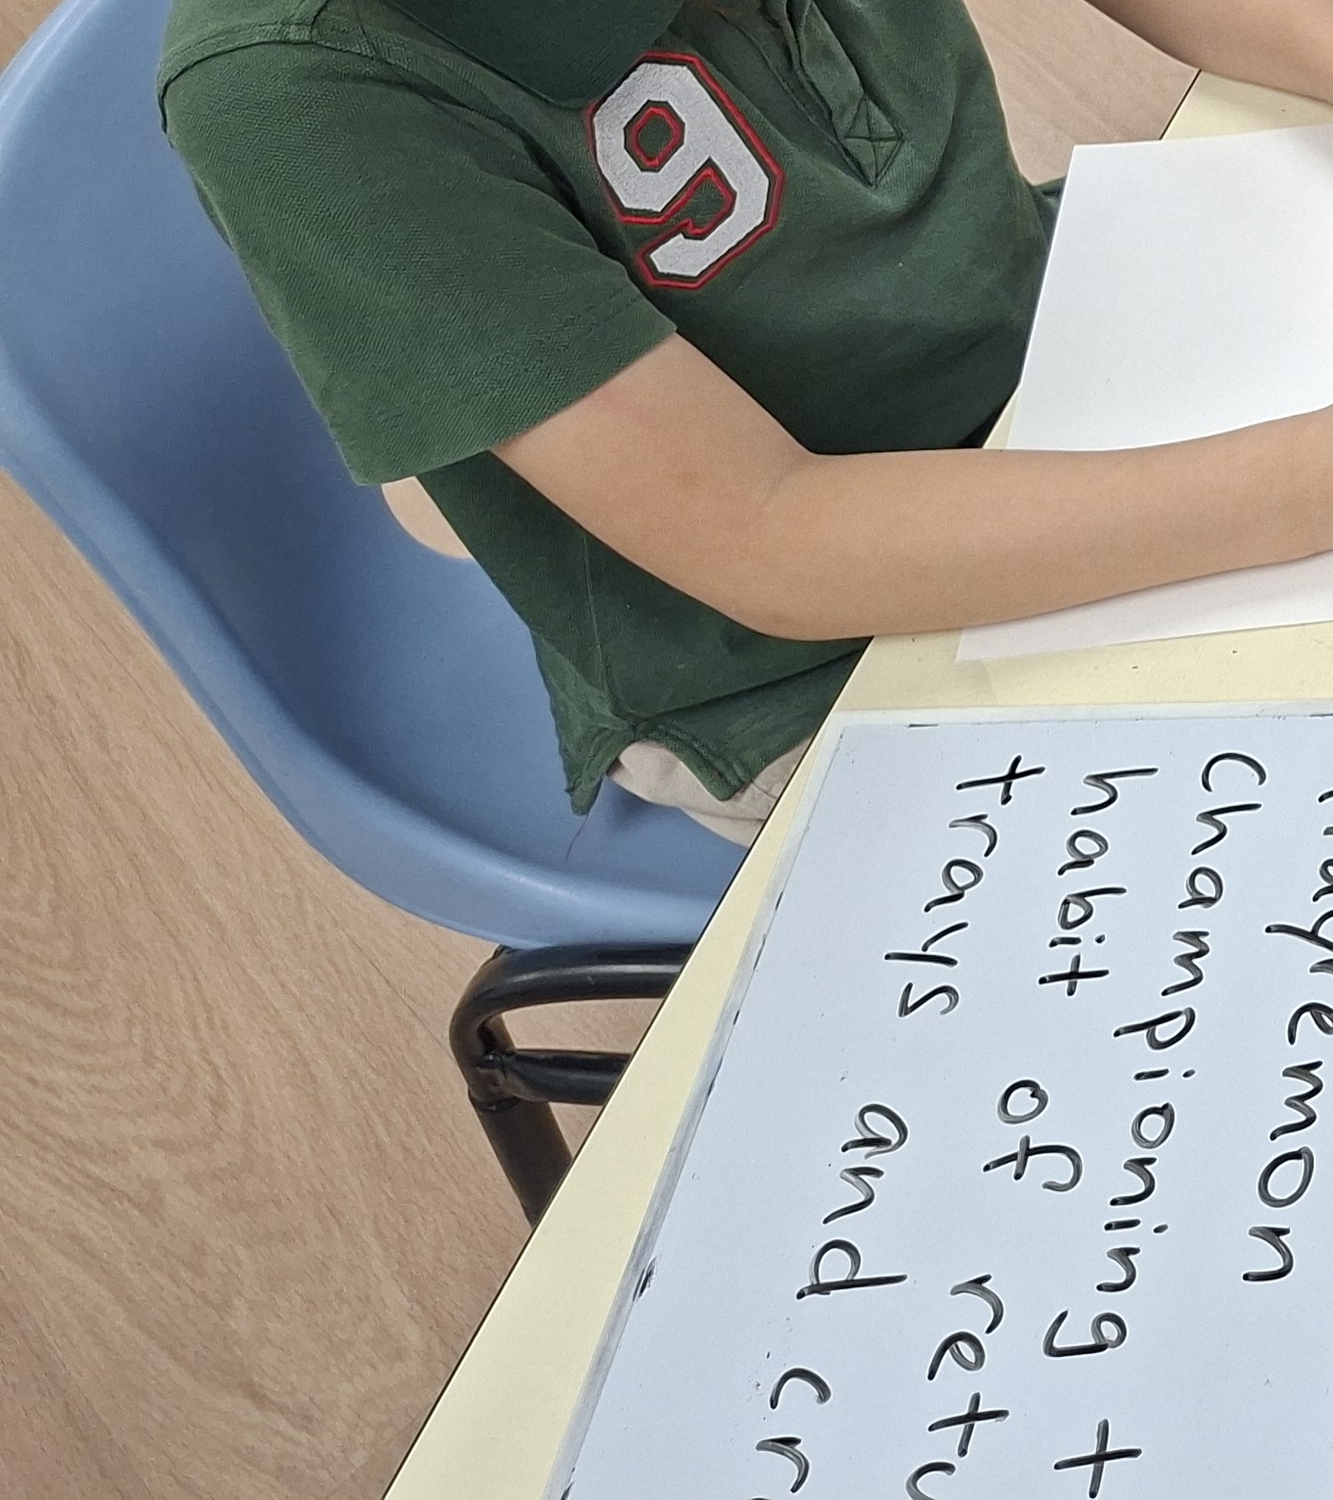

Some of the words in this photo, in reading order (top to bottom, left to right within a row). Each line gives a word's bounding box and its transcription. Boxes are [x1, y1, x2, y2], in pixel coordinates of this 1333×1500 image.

[585, 49, 786, 289] 9
[883, 754, 1046, 1018] trays
[1038, 766, 1160, 997] habit
[796, 1102, 909, 1301] and
[982, 1079, 1084, 1193] of
